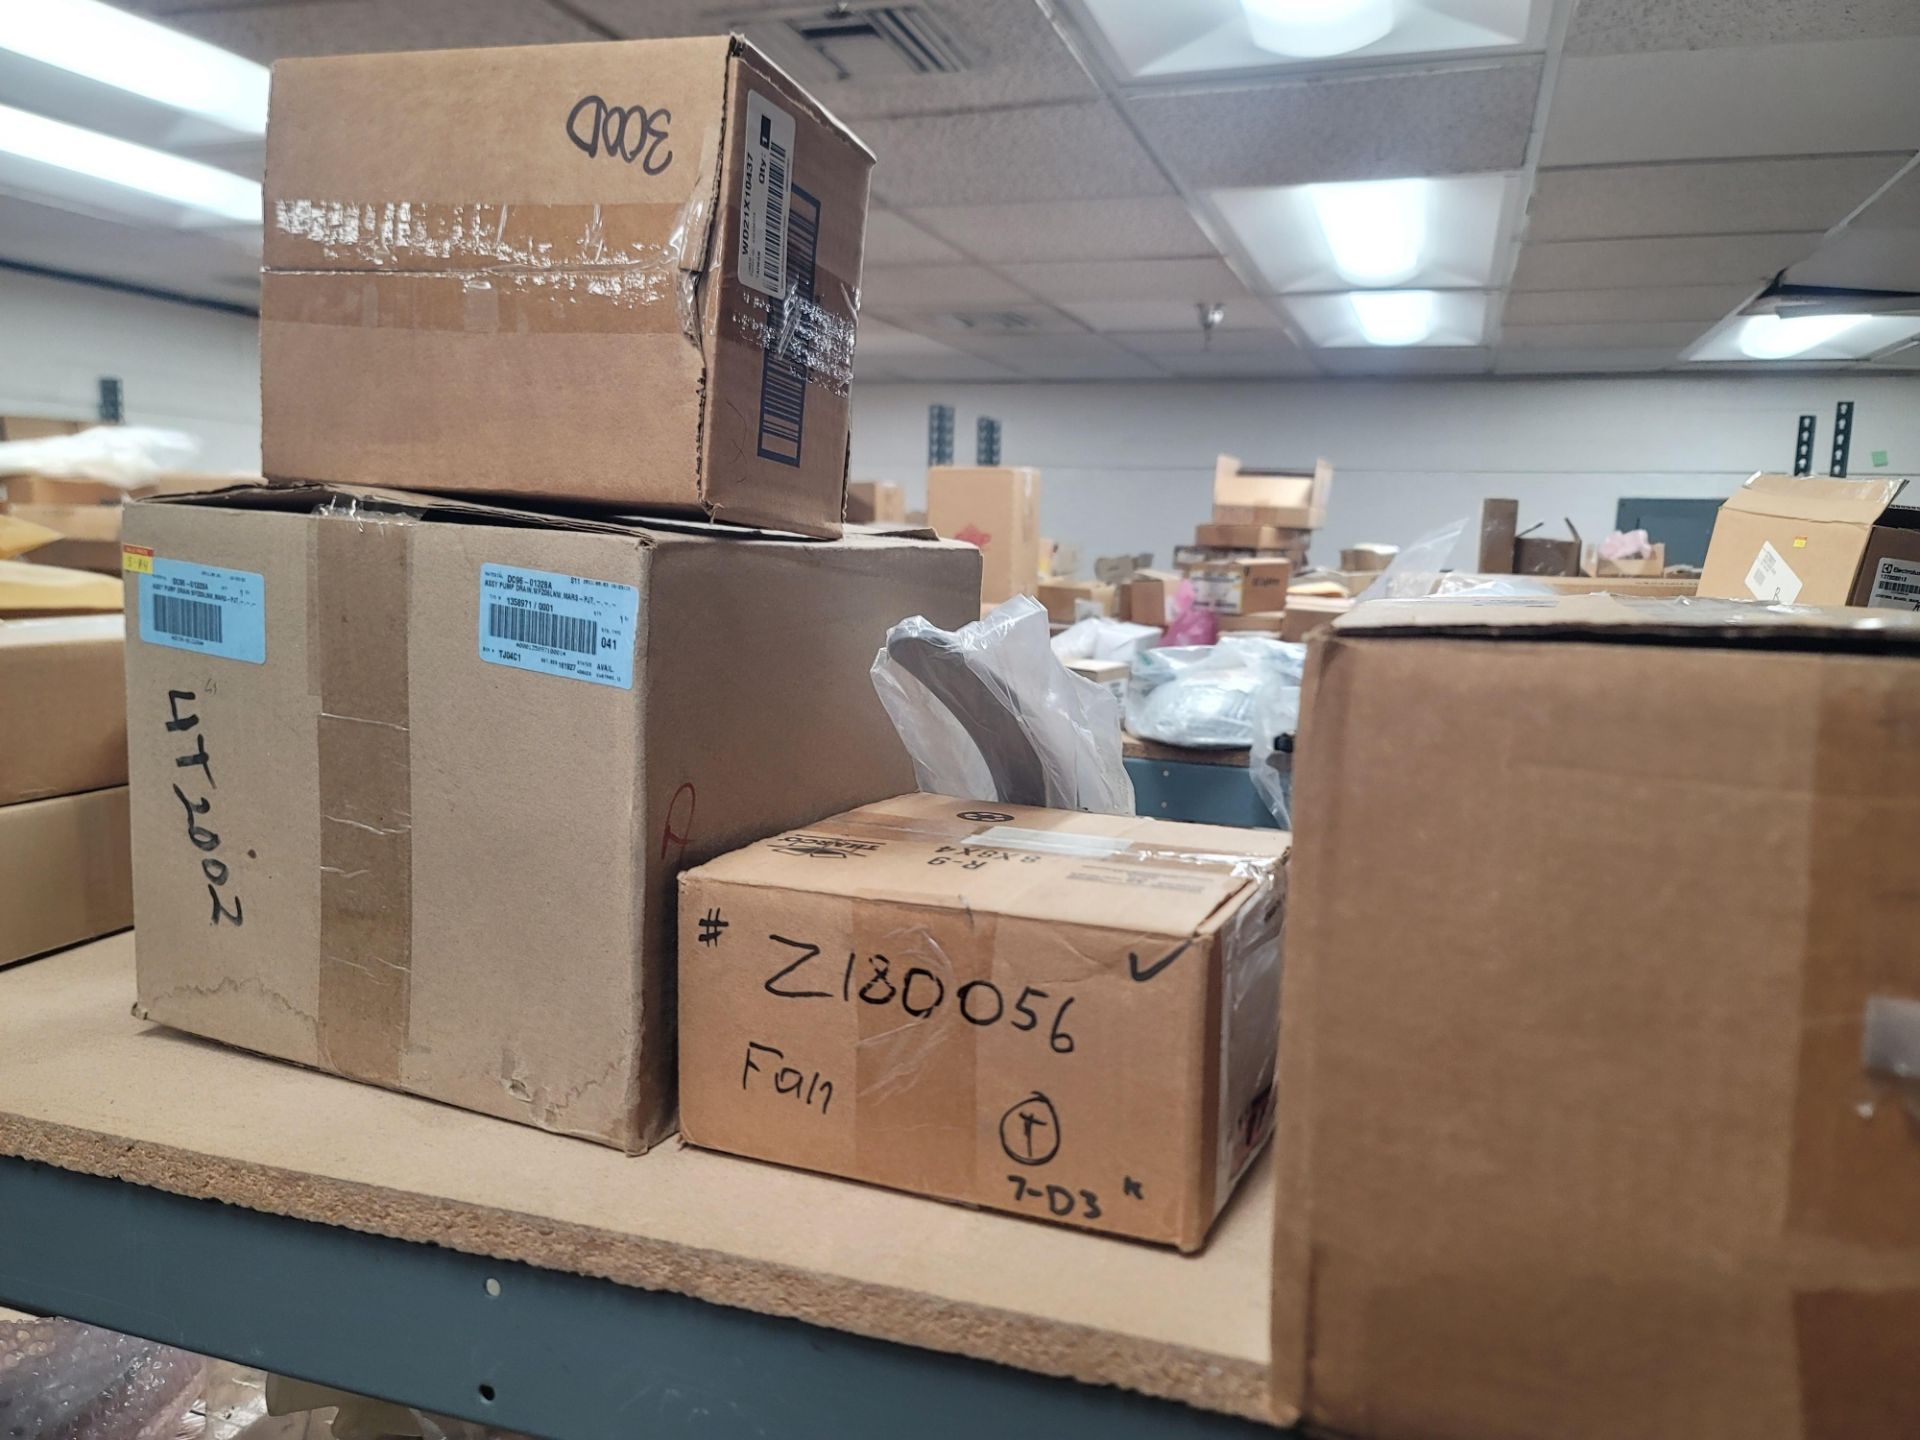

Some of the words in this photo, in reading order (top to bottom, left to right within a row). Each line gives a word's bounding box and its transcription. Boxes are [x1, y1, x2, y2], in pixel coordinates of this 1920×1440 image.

[566, 95, 673, 176] 300D
[742, 152, 754, 256] WD21X10437
[601, 636, 617, 651] 041
[927, 856, 988, 870] R-9
[764, 934, 1075, 1054] Z180056
[742, 1041, 835, 1115] Fan
[1006, 1174, 1102, 1220] 7-D3
